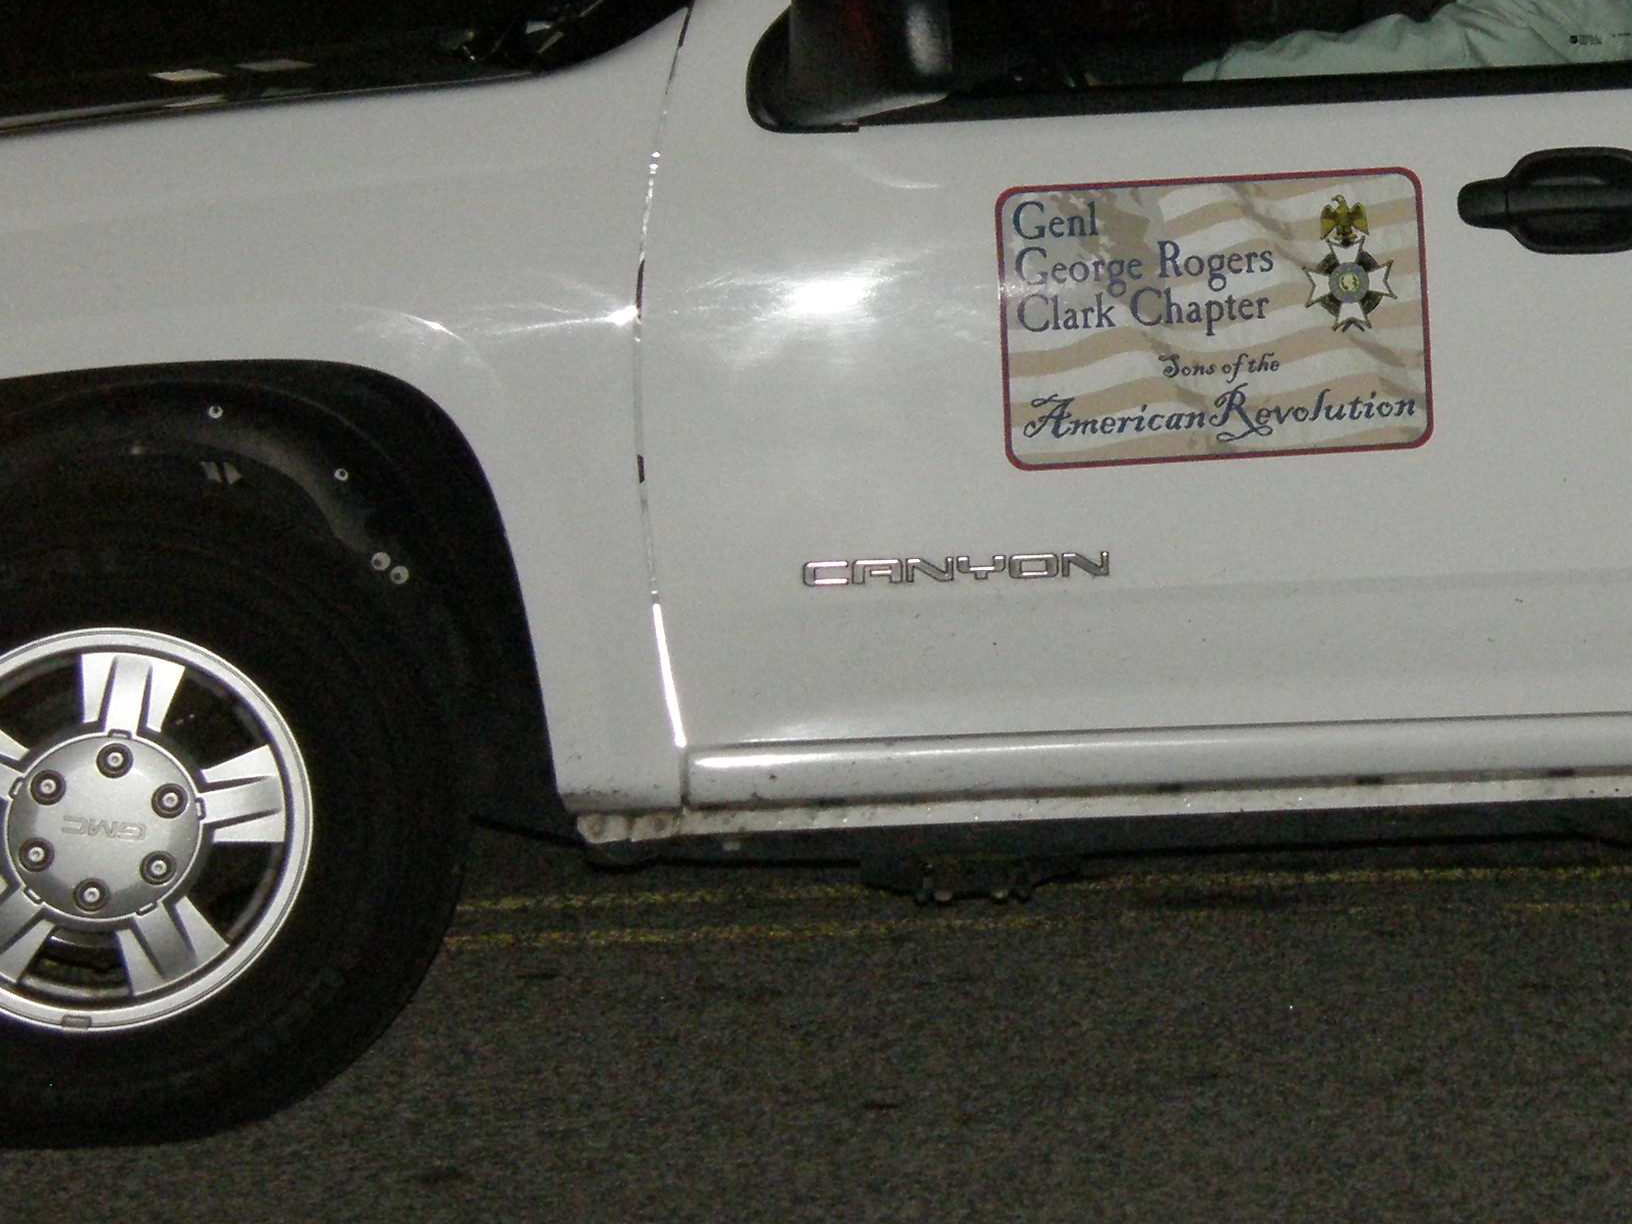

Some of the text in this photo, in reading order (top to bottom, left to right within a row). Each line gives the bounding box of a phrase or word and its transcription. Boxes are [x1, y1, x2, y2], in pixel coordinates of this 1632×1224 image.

[1013, 201, 1098, 240] Genl
[1015, 240, 1274, 297] George Rogers
[1017, 287, 1270, 336] Clark Chapter
[1159, 352, 1280, 382] Sons of the
[1023, 383, 1416, 442] American Revolution
[802, 551, 1110, 587] CANYON
[62, 814, 146, 841] GMC
